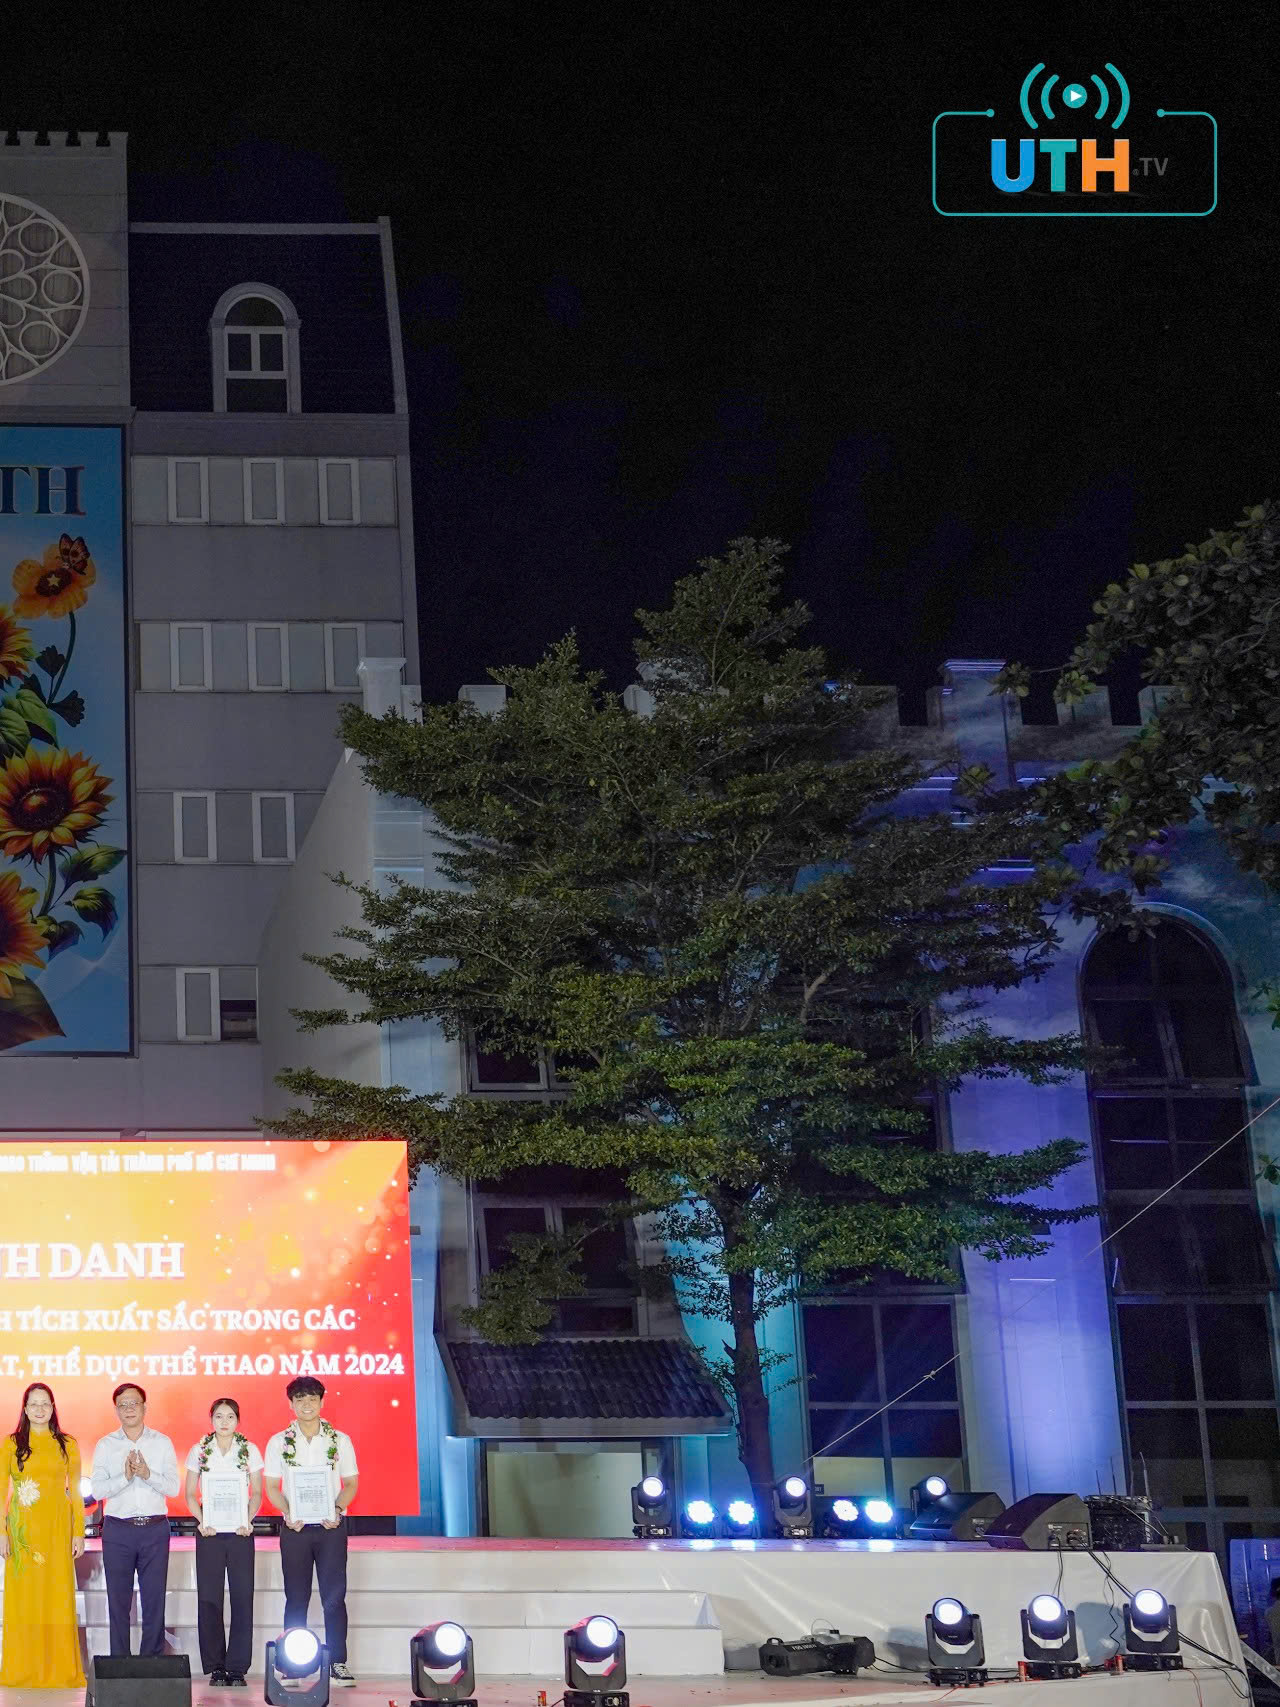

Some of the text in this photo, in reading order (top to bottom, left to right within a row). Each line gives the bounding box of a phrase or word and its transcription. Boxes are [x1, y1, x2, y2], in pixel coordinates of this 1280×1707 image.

[47, 1242, 185, 1280] DANH
[15, 1306, 80, 1331] TÍCH
[83, 1302, 153, 1331] XUẤT
[209, 1309, 300, 1331] TRONG
[304, 1304, 356, 1331] CÁC
[27, 1346, 81, 1377] THỂ
[85, 1354, 140, 1382] DỤC
[143, 1346, 197, 1376] THỂ
[200, 1354, 275, 1376] THAO
[279, 1350, 341, 1376] NĂM
[344, 1352, 405, 1376] 2024
